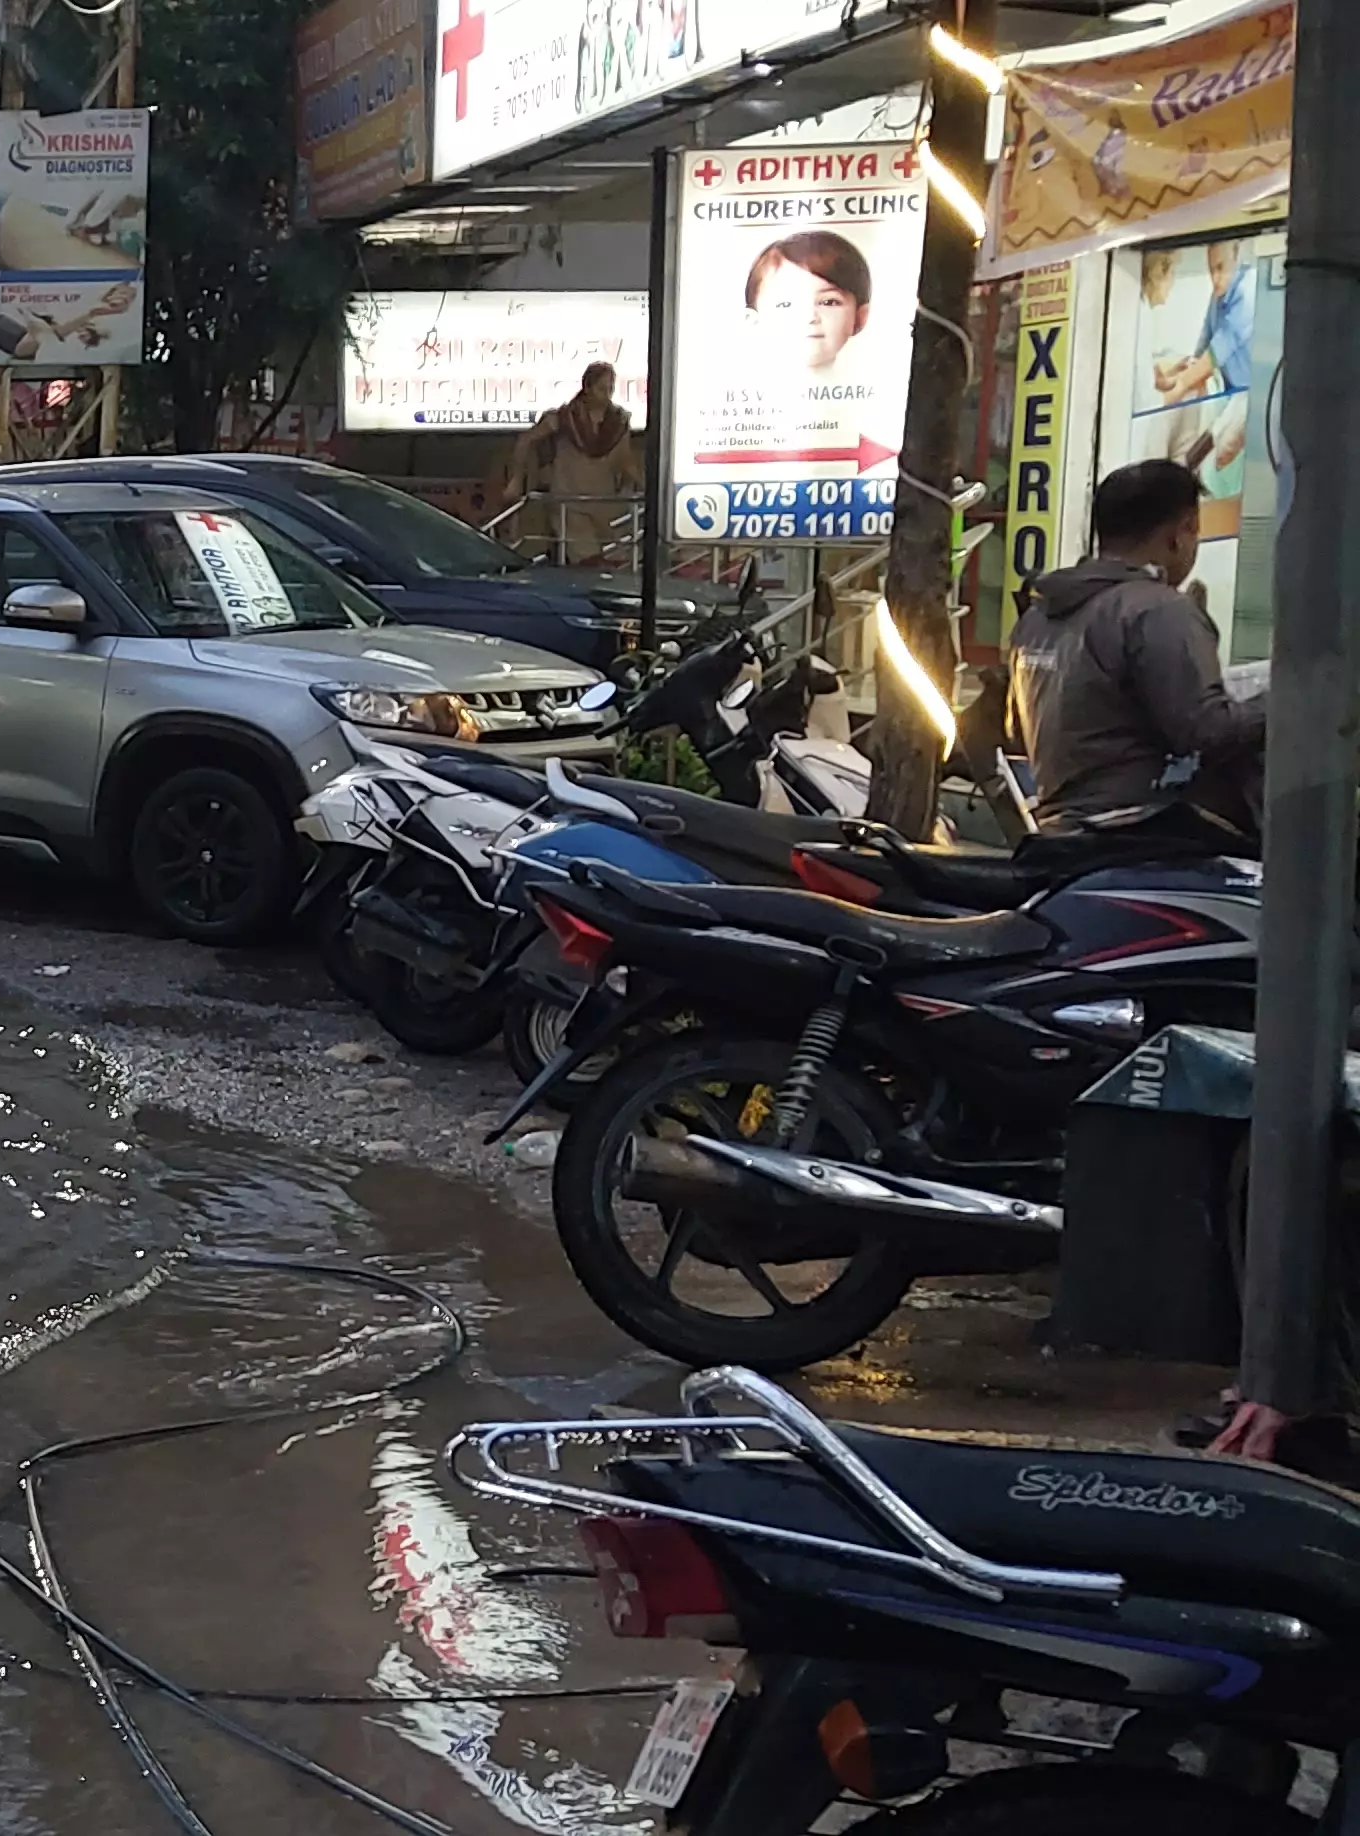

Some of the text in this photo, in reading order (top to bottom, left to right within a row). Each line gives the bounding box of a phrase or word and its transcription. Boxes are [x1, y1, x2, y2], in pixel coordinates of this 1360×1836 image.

[47, 134, 134, 153] KRISHNA
[46, 159, 133, 174] DIAGNOSTICS
[737, 153, 879, 185] ADITHYA
[693, 194, 920, 221] CHILDREN'S CLINIC
[1027, 278, 1068, 298] DIGITAL
[20, 294, 60, 303] CHECK
[65, 294, 81, 303] UP
[1027, 299, 1067, 319] STUDIO
[423, 410, 483, 423] WHOLE
[488, 410, 529, 423] SALE
[731, 481, 797, 508] 7075
[805, 480, 854, 506] 101
[730, 513, 796, 539] 7075
[804, 512, 852, 537] 111
[1008, 1465, 1246, 1520] Splendor+
